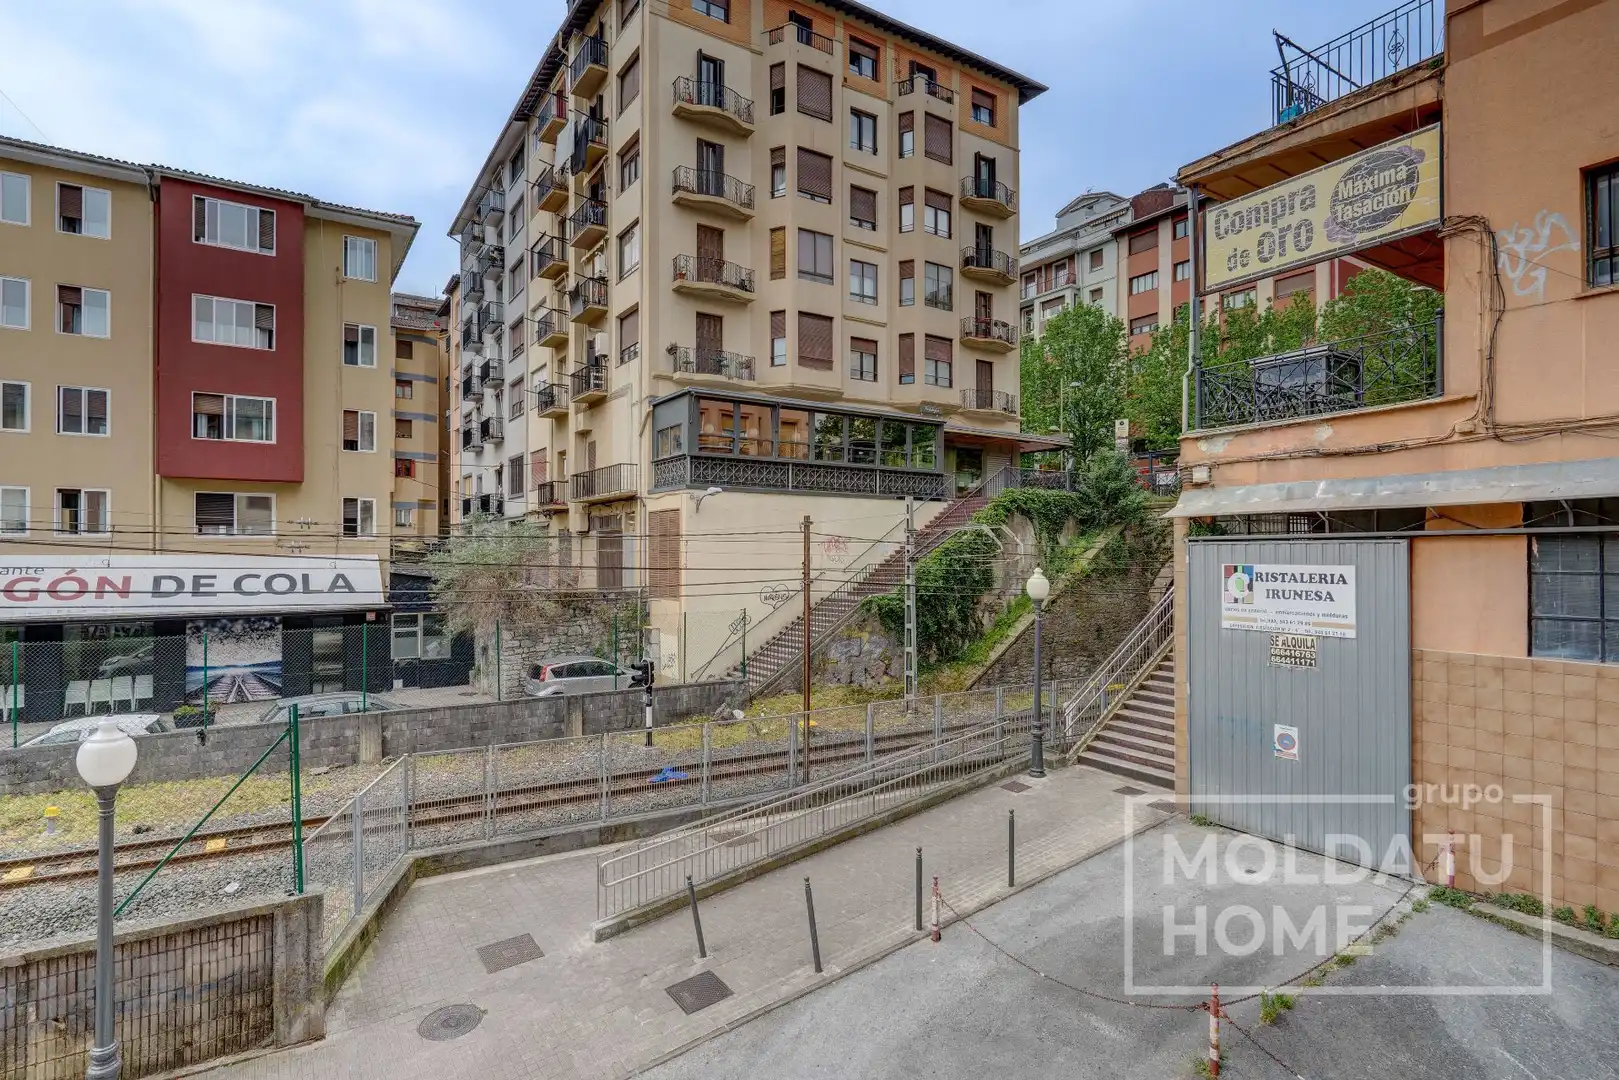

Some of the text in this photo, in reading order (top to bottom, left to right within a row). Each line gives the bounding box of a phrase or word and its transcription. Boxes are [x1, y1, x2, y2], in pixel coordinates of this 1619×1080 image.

[1337, 164, 1408, 201] Máxima
[1214, 184, 1317, 240] Compra
[1334, 186, 1411, 222] Tasación
[1226, 219, 1314, 273] de oro
[151, 574, 218, 599] DE
[233, 572, 357, 597] COLA
[1265, 588, 1336, 603] IRUNESA
[1270, 635, 1316, 651] SE ALQUILA
